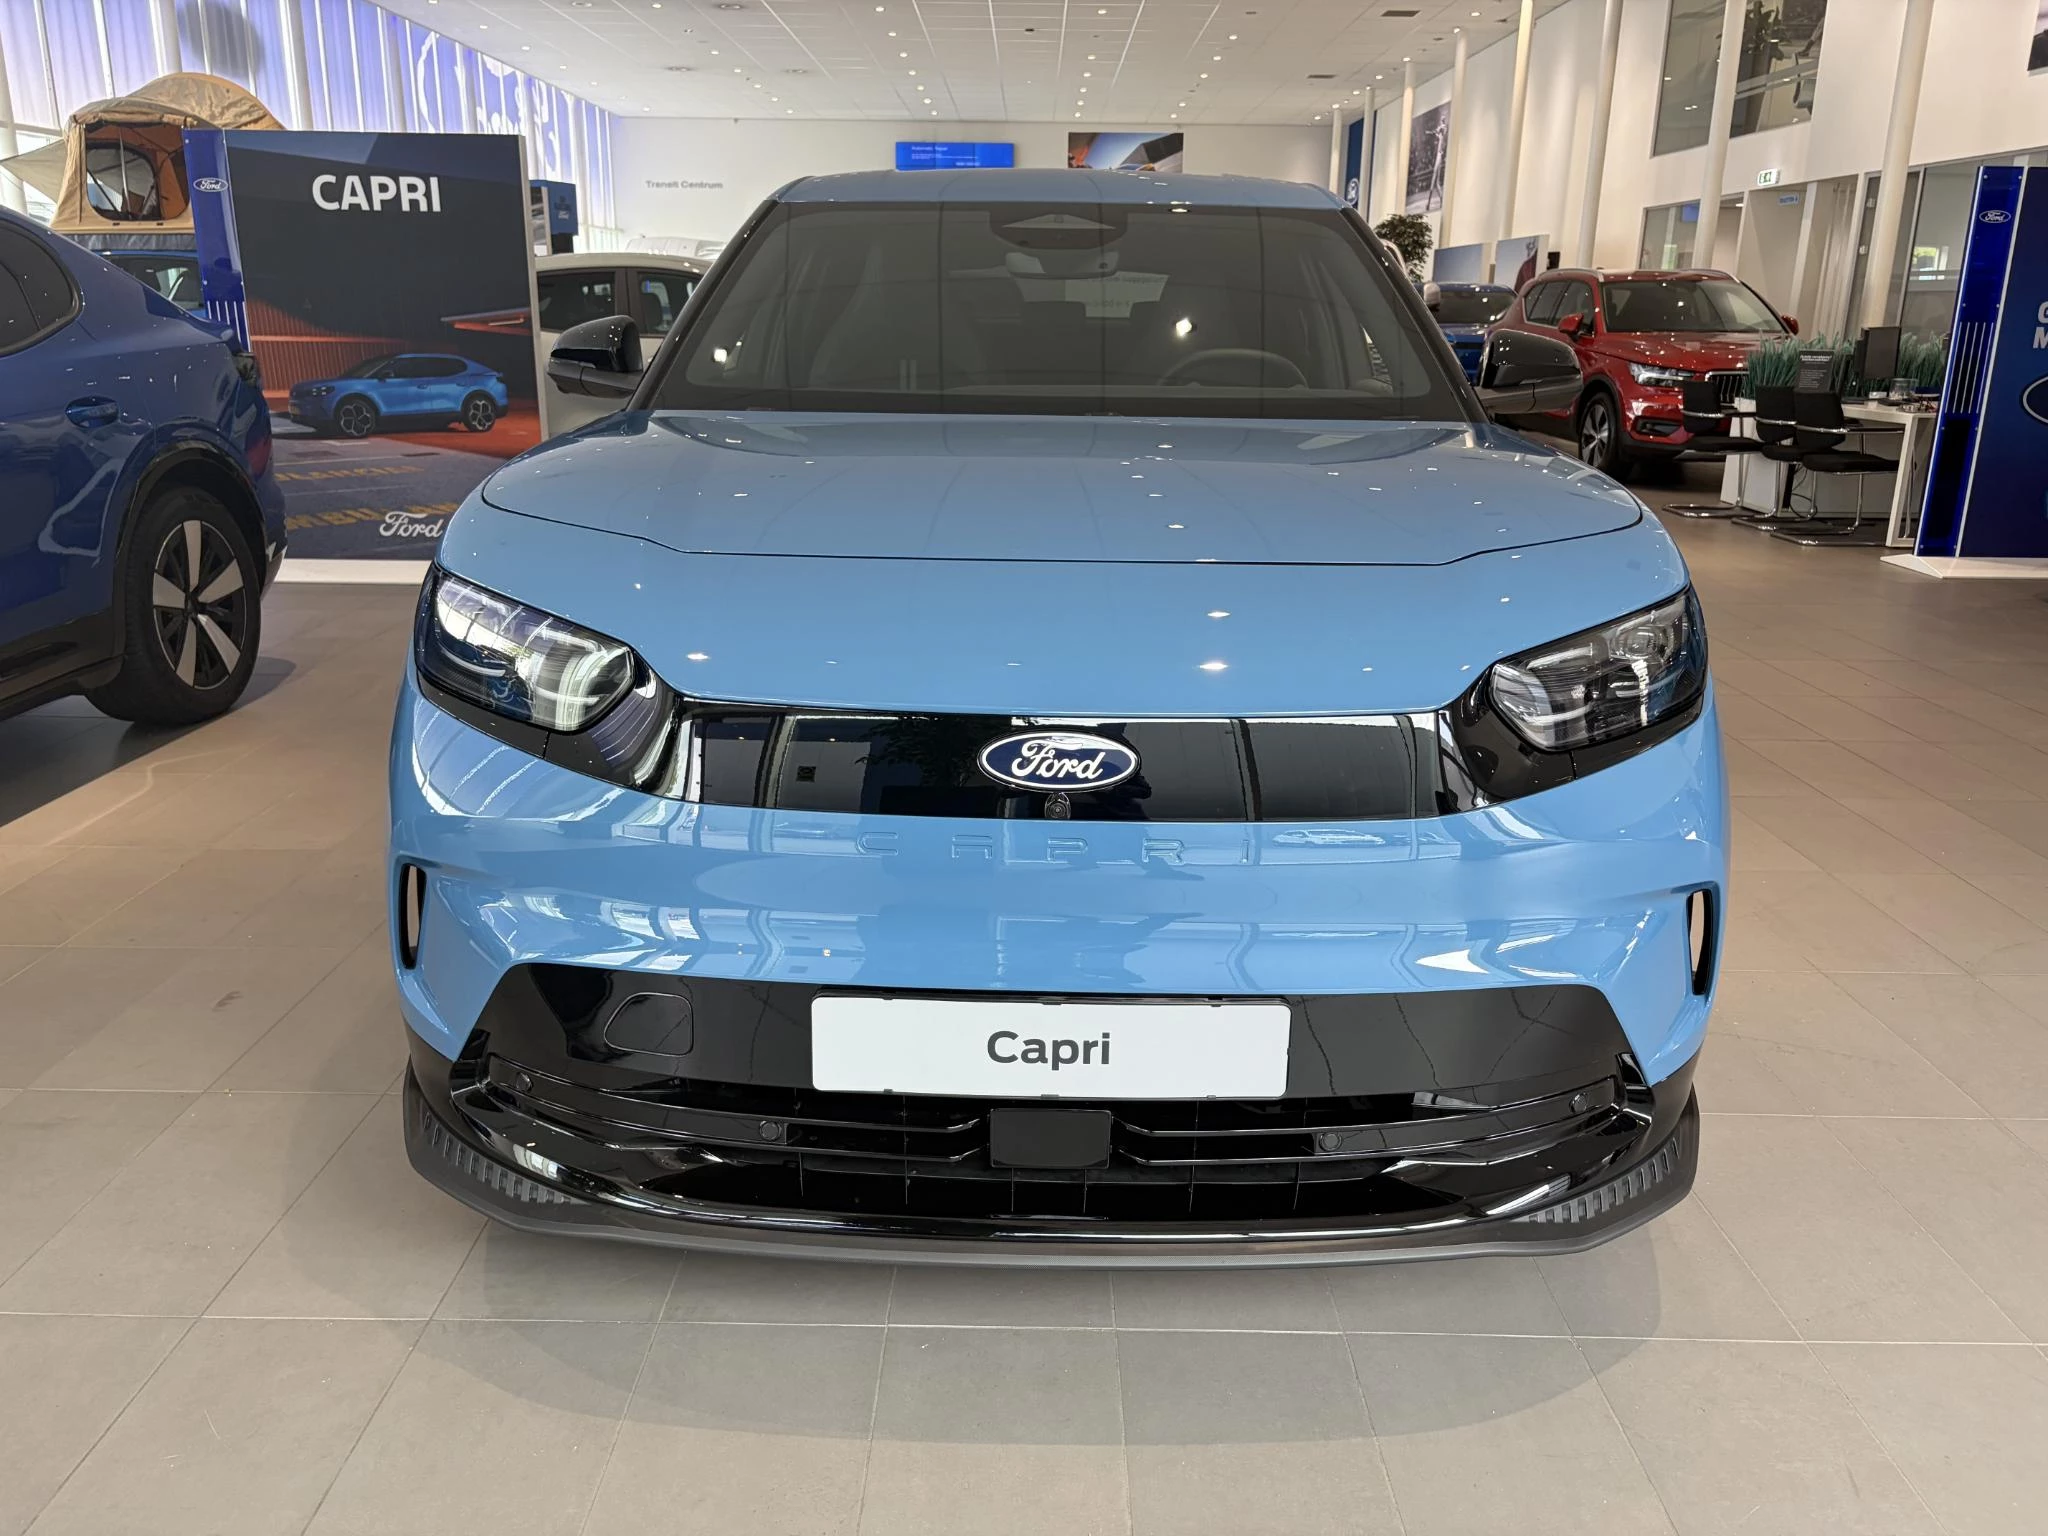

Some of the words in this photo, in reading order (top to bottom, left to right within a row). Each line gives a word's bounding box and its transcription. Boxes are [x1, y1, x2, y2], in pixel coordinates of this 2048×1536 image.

[312, 174, 442, 213] CAPRI
[680, 180, 724, 189] Centrum
[379, 511, 444, 538] Ford
[1011, 739, 1106, 779] Ford
[855, 831, 1250, 865] CAPRI
[987, 1030, 1110, 1071] Capri
